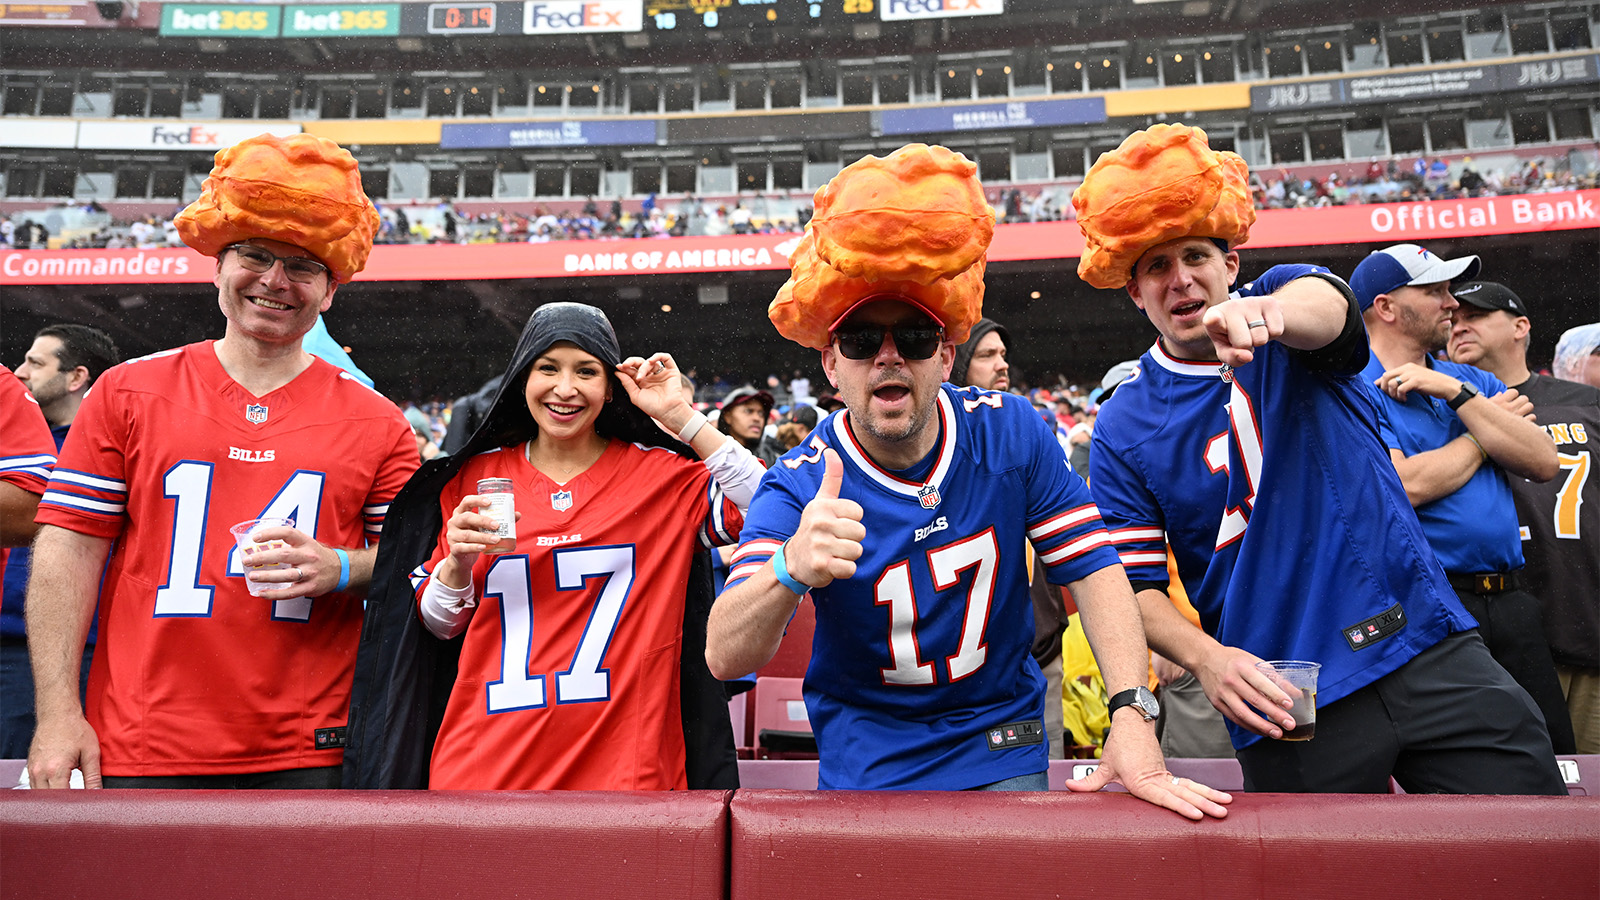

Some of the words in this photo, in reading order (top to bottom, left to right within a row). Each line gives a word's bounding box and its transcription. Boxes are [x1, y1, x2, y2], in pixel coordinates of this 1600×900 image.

[172, 9, 268, 31] bet365
[294, 9, 387, 31] bet365
[532, 3, 623, 28] FedEx
[152, 126, 217, 145] FedEx
[1370, 200, 1497, 233] Official
[1512, 193, 1595, 224] Bank
[4, 252, 189, 277] Commanders
[564, 253, 628, 272] BANK
[632, 251, 663, 270] OF
[665, 247, 772, 268] AMERICA
[1223, 368, 1235, 381] NF
[249, 411, 264, 420] NFL
[1538, 423, 1588, 446] NG
[229, 446, 276, 463] BILLS
[554, 499, 571, 509] NFL
[922, 493, 940, 507] NFL
[914, 516, 949, 542] BILLS
[152, 459, 326, 622] 14
[537, 534, 582, 547] BILLS
[874, 525, 1000, 686] 17
[483, 543, 636, 715] 17
